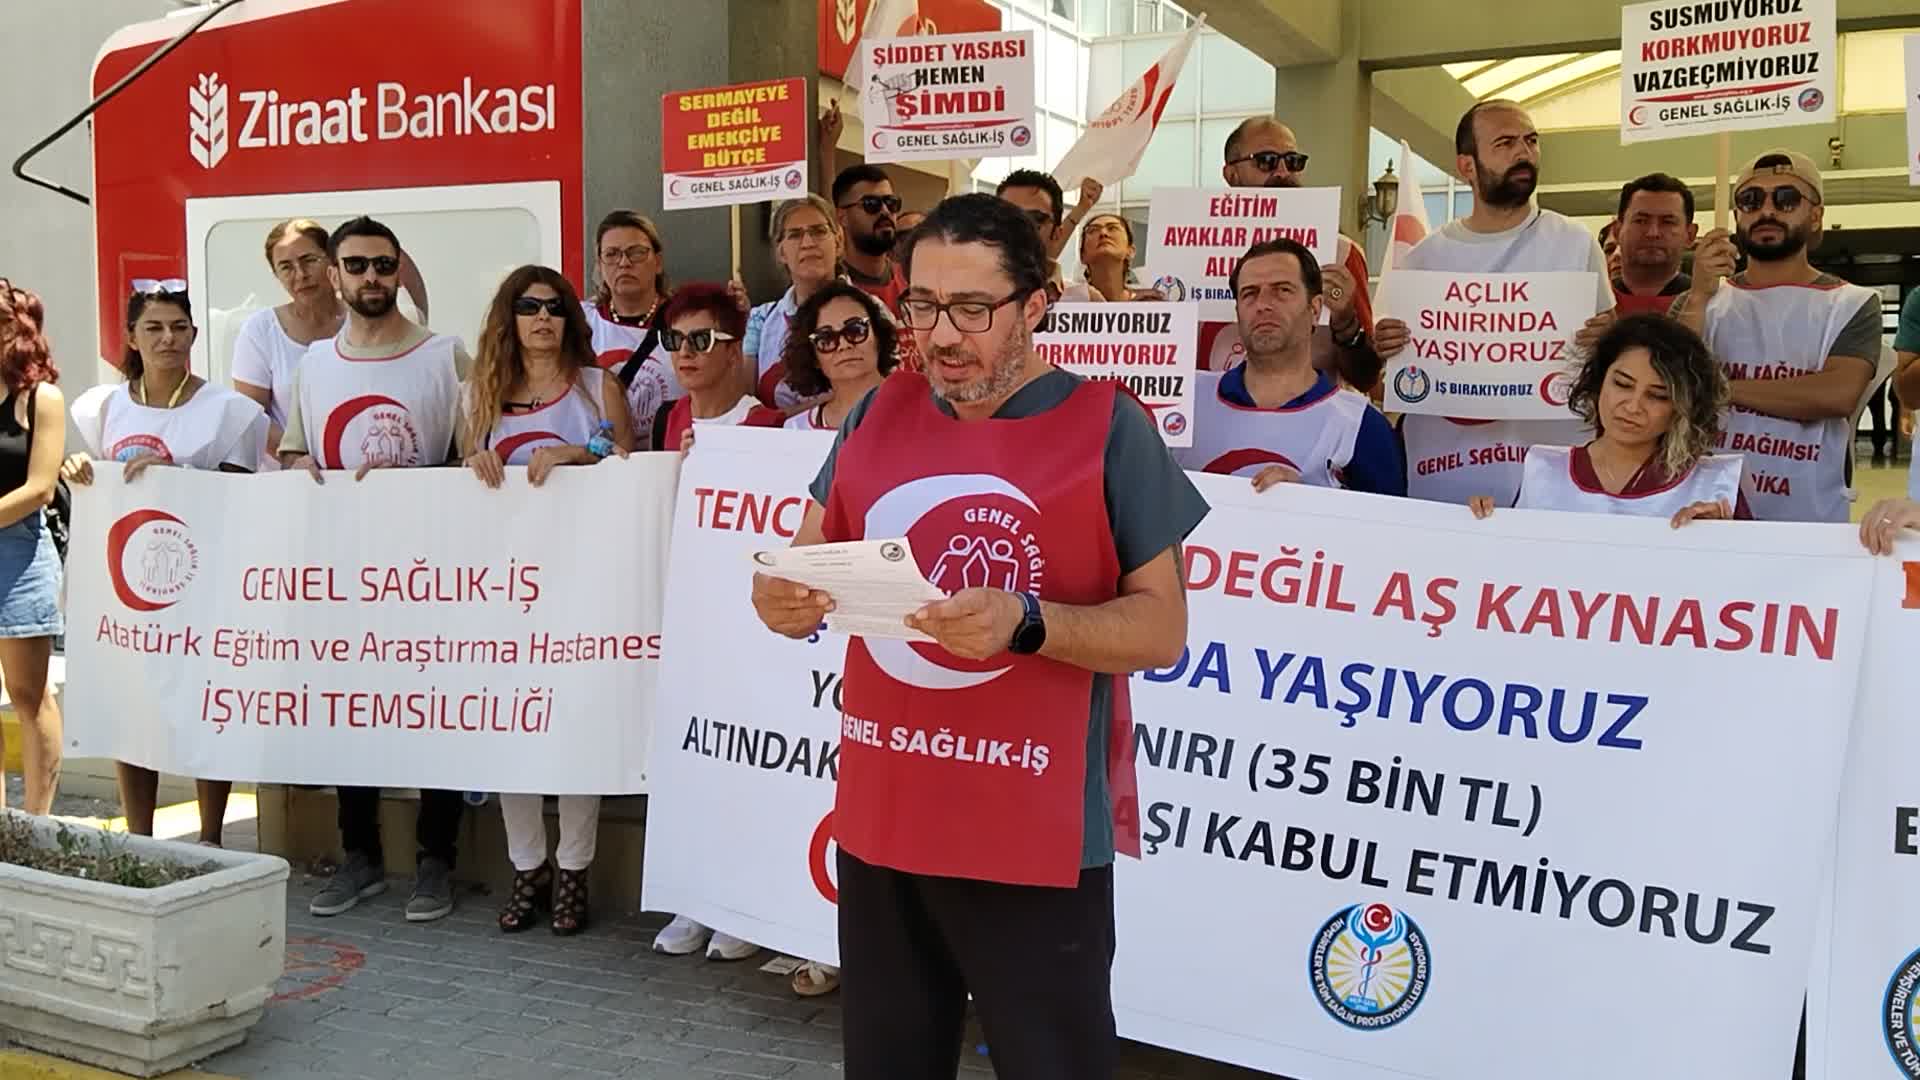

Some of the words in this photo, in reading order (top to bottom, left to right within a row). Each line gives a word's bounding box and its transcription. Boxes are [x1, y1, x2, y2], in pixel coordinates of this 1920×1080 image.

[1650, 0, 1803, 31] SUSMUYORUZ
[873, 43, 946, 69] ŞİDDET
[952, 39, 1025, 61] YASASI
[1641, 22, 1811, 62] KORKMUYORUZ
[915, 65, 984, 87] HEMEN
[1633, 52, 1819, 93] VAZGEÇMİYORUZ
[679, 84, 788, 111] SERMAYEYE
[896, 85, 1005, 120] ŞİMDİ
[1659, 105, 1708, 122] GENEL
[1713, 93, 1791, 115] SAĞLIK-İŞ
[238, 87, 368, 148] Ziraat
[377, 76, 555, 140] Bankası
[707, 106, 762, 129] DEĞİL
[687, 125, 781, 150] EMEKÇİYE
[897, 134, 938, 148] GENEL
[942, 129, 1004, 146] SAĞLIK-İŞ
[703, 147, 766, 168] BÜTÇE
[690, 181, 725, 194] GENEL
[728, 175, 781, 190] SAĞLIK-İŞ
[1210, 193, 1278, 218] EĞİTİM
[1164, 226, 1247, 247] AYAKLAR
[1205, 257, 1240, 277] ALI
[1191, 286, 1202, 300] İŞ
[1205, 288, 1236, 300] BIRA
[1445, 281, 1529, 308] AÇLIK
[1046, 312, 1172, 334] USMUYORUZ
[1420, 309, 1558, 333] SINIRINDA
[1036, 343, 1178, 366] ORKMUYORUZ
[1412, 338, 1567, 366] YAŞIYORUZ
[1435, 380, 1448, 394] İŞ
[1450, 382, 1533, 397] BIRAKIYORUZ
[1417, 452, 1464, 476] GENEL
[1752, 470, 1790, 497] İKA
[695, 488, 813, 538] TENC
[964, 507, 1021, 535] GENEL
[242, 566, 348, 602] GENEL
[360, 557, 540, 613] SAĞLIK-İŞ
[1184, 545, 1356, 613] DEĞİL
[1372, 571, 1459, 638] AŞ
[1476, 582, 1839, 661] KAYNASIN
[96, 615, 203, 656] Atatürk
[213, 628, 300, 667] Eğitim
[310, 638, 350, 661] ve
[360, 631, 518, 673] Araştırma
[529, 631, 662, 664] Hastanes
[201, 680, 308, 734] İŞYERİ
[321, 685, 553, 733] TEMSİLCİLİĞİ
[1254, 648, 1649, 750] YAŞIYORUZ
[682, 716, 841, 781] ALTINDAK
[843, 713, 883, 748] GENEL
[889, 727, 1050, 776] SAĞLIK-İŞ
[1134, 722, 1235, 780] NIRI
[1249, 743, 1332, 796] (35
[1346, 755, 1446, 817] BİN
[1459, 776, 1543, 837] TL)
[1203, 811, 1389, 889] KABUL
[1405, 848, 1776, 955] ETMİYORUZ
[1327, 1000, 1357, 1024] SAĞLIK
[1893, 1030, 1909, 1049] VE
